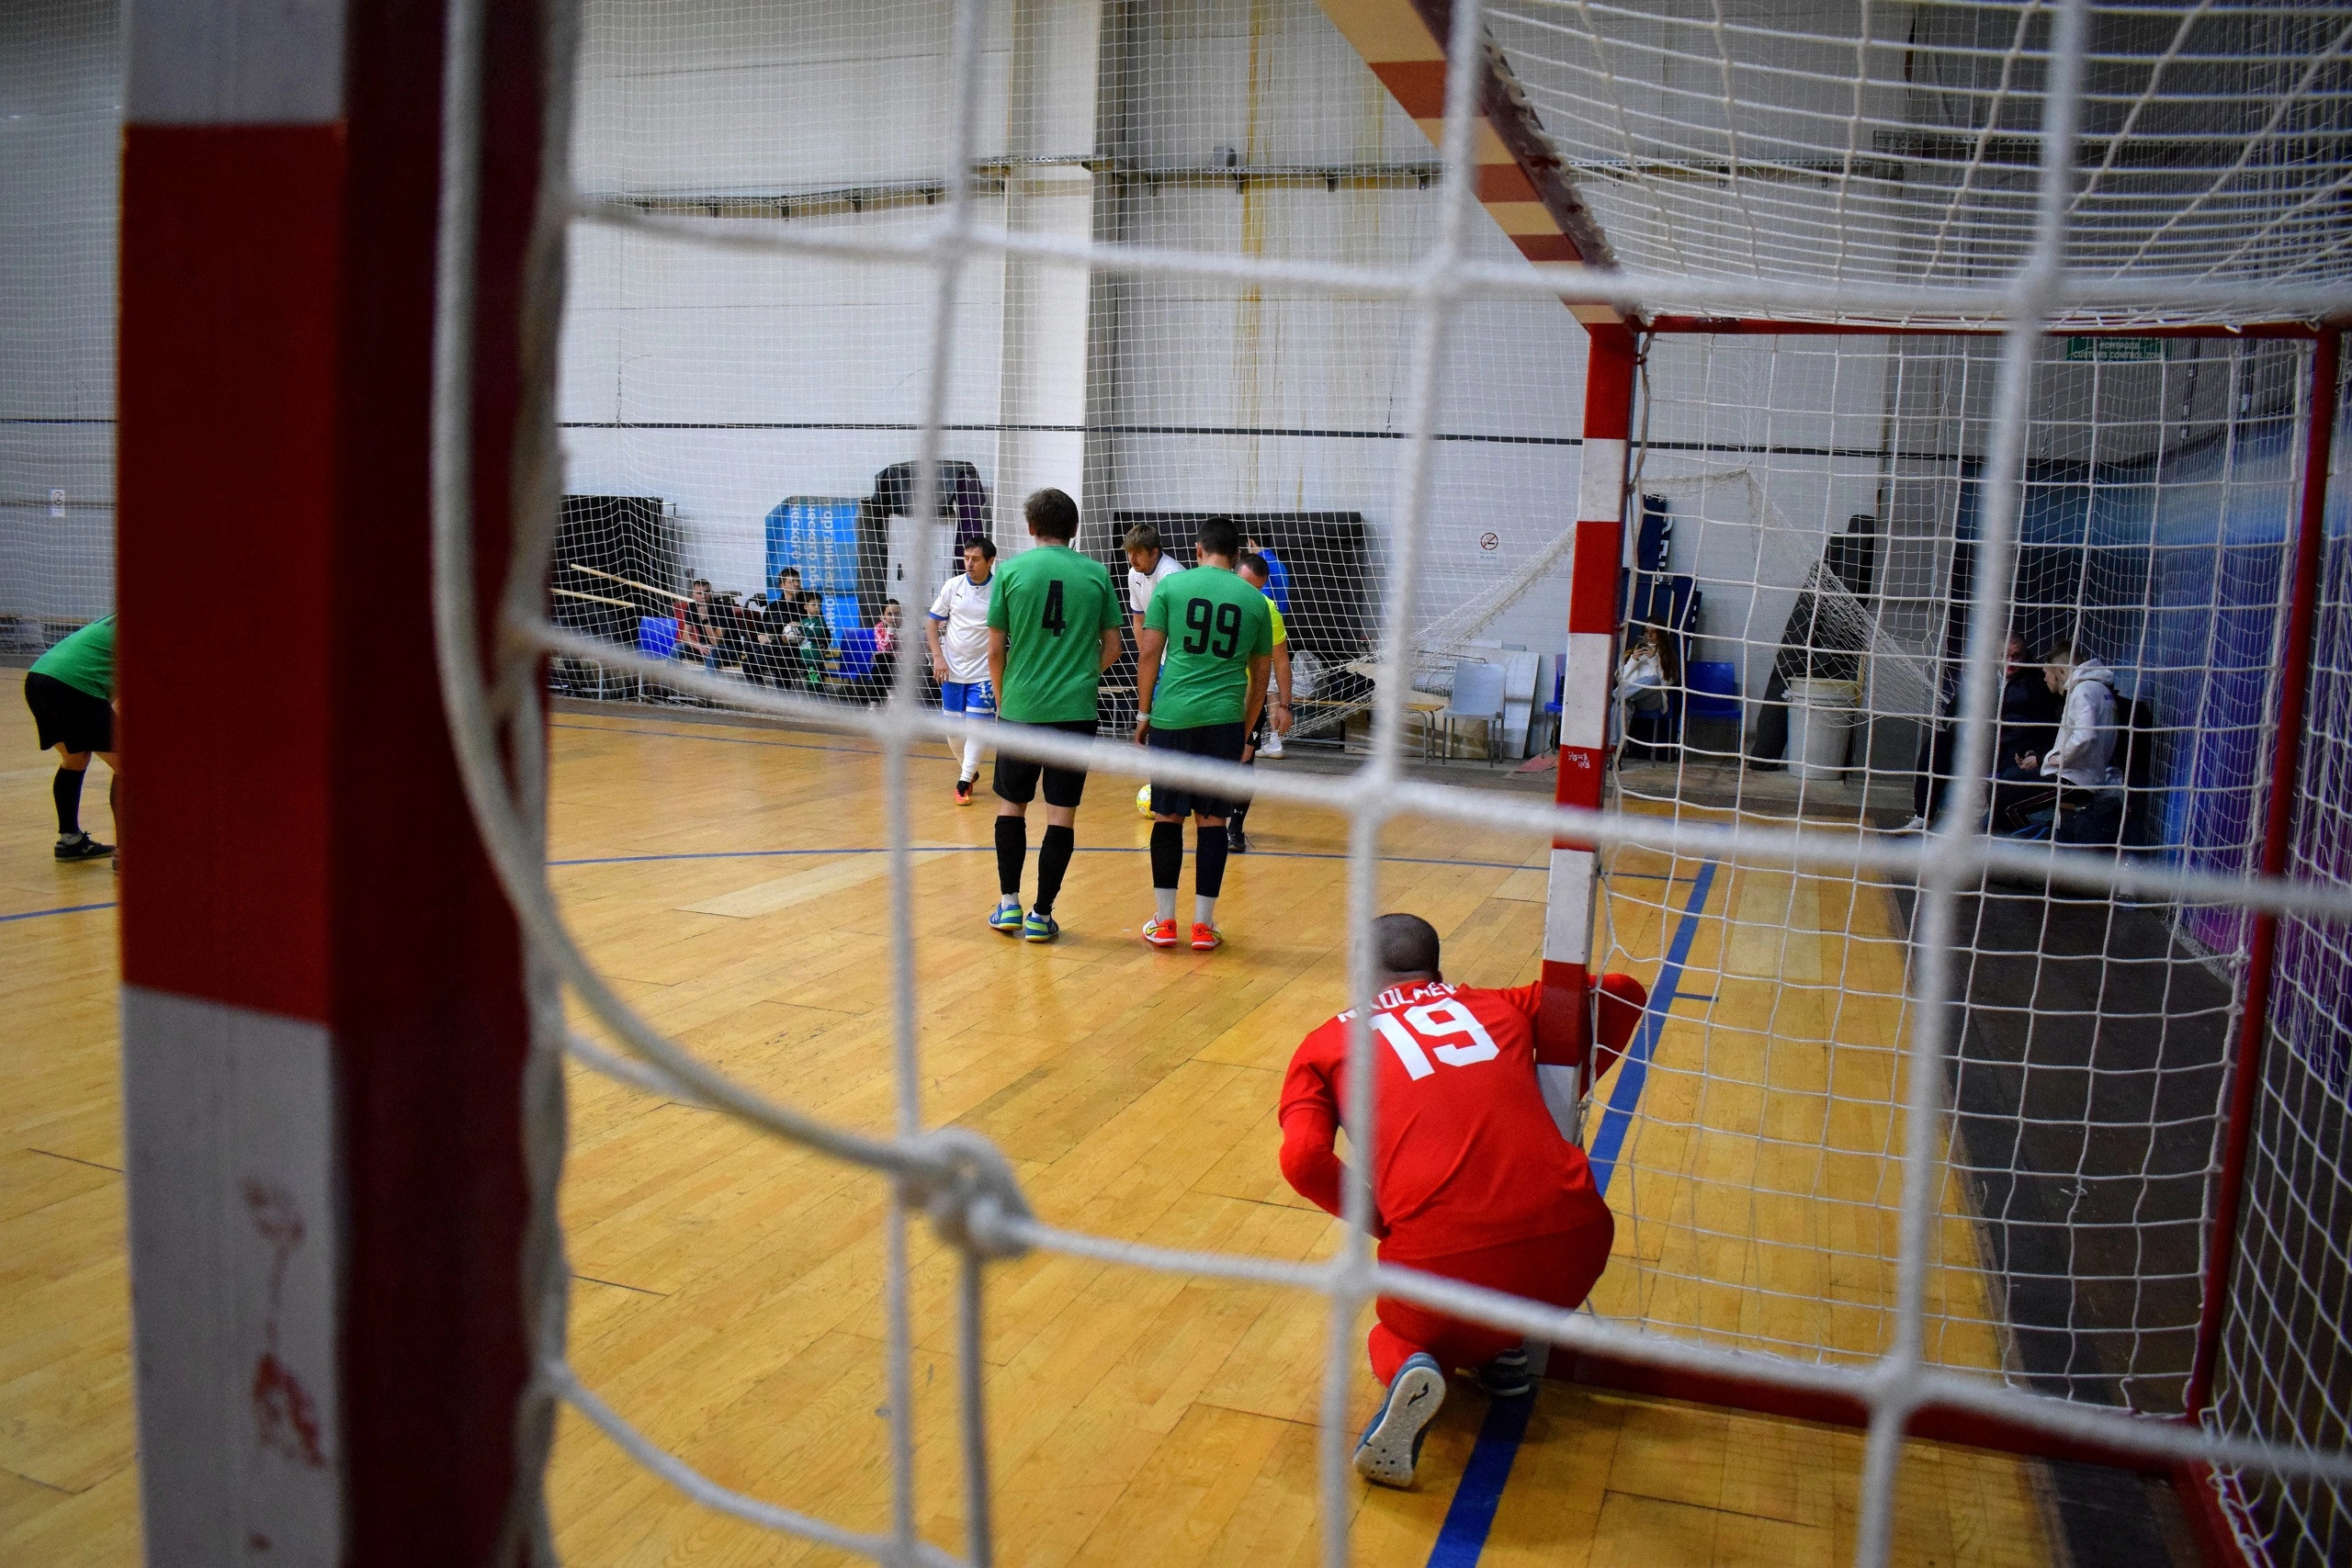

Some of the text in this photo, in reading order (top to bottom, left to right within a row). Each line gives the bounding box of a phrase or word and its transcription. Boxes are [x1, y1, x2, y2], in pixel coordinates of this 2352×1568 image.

[2109, 351, 2143, 359] CONTROL
[2145, 351, 2162, 359] ZON
[1042, 580, 1067, 637] 4
[1182, 597, 1242, 660] 99
[1367, 997, 1500, 1082] 19
